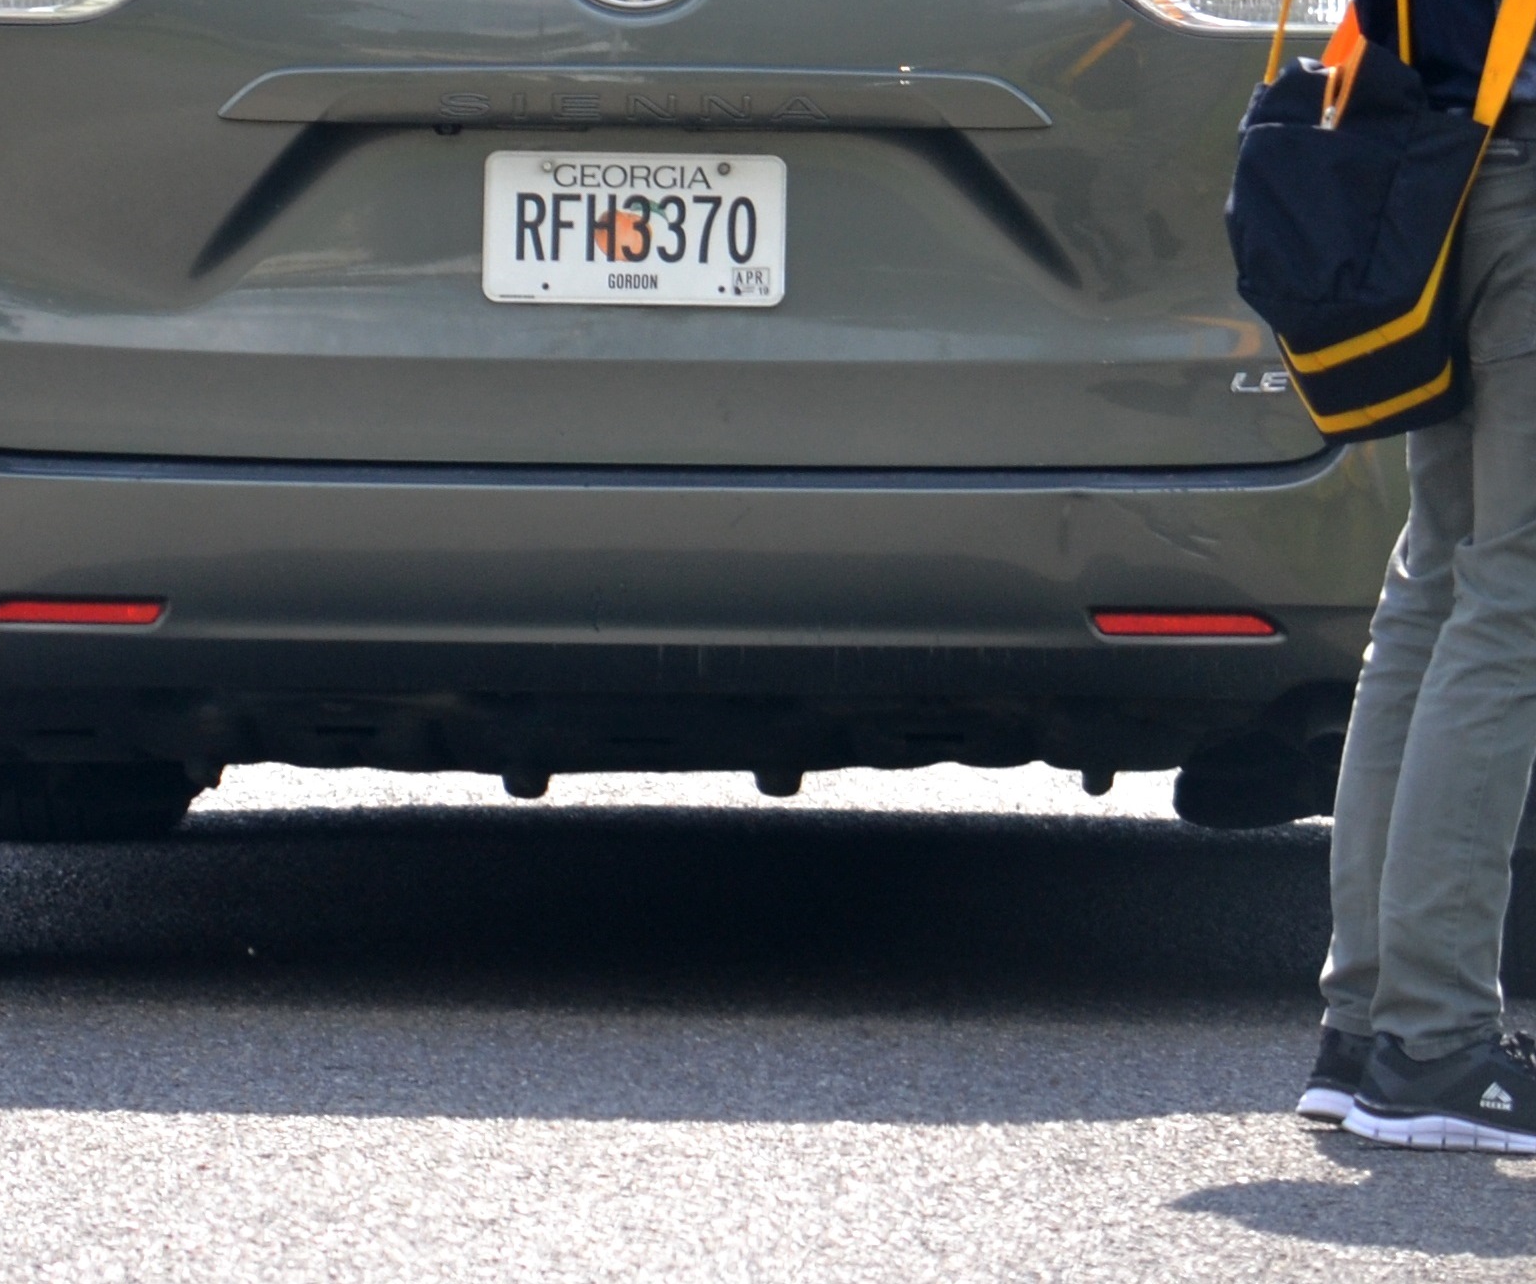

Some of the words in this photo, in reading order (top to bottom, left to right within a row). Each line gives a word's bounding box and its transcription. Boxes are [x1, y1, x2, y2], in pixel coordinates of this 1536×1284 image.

[439, 92, 831, 123] SIENNA
[553, 164, 712, 190] GEORGIA
[515, 192, 757, 264] RFH3370
[608, 274, 658, 290] GORDON
[735, 270, 763, 285] APR
[1230, 371, 1290, 393] LE
